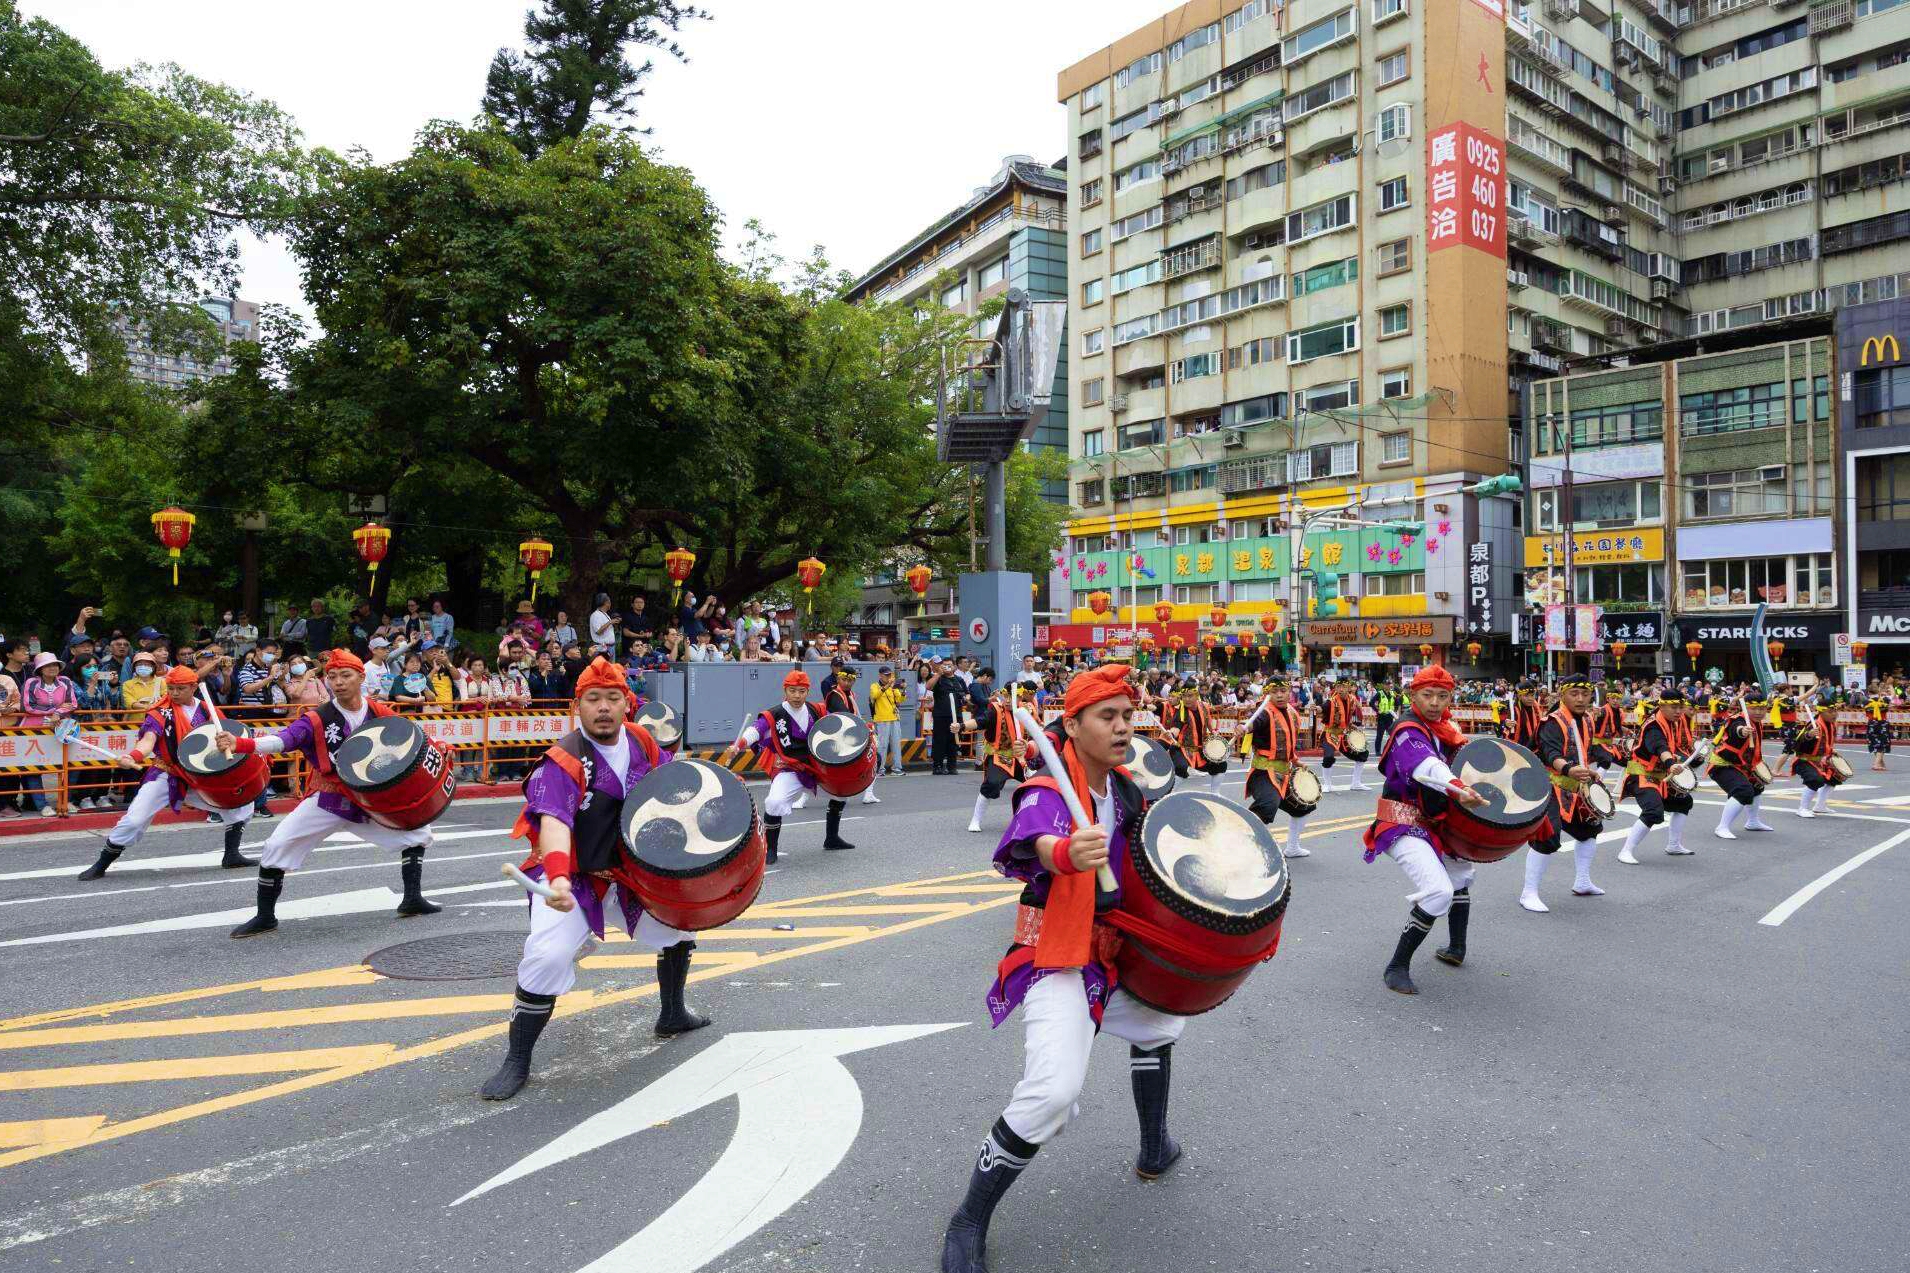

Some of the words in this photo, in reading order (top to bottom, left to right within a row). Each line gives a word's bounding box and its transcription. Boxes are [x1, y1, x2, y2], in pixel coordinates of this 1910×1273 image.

[1467, 136, 1500, 176] 0925
[1431, 131, 1457, 240] 廣告洽
[1471, 174, 1496, 209] 460
[1472, 208, 1496, 242] 037
[1010, 623, 1022, 662] 北投
[1310, 622, 1357, 636] Carrefour
[500, 719, 563, 734] 車輛改道
